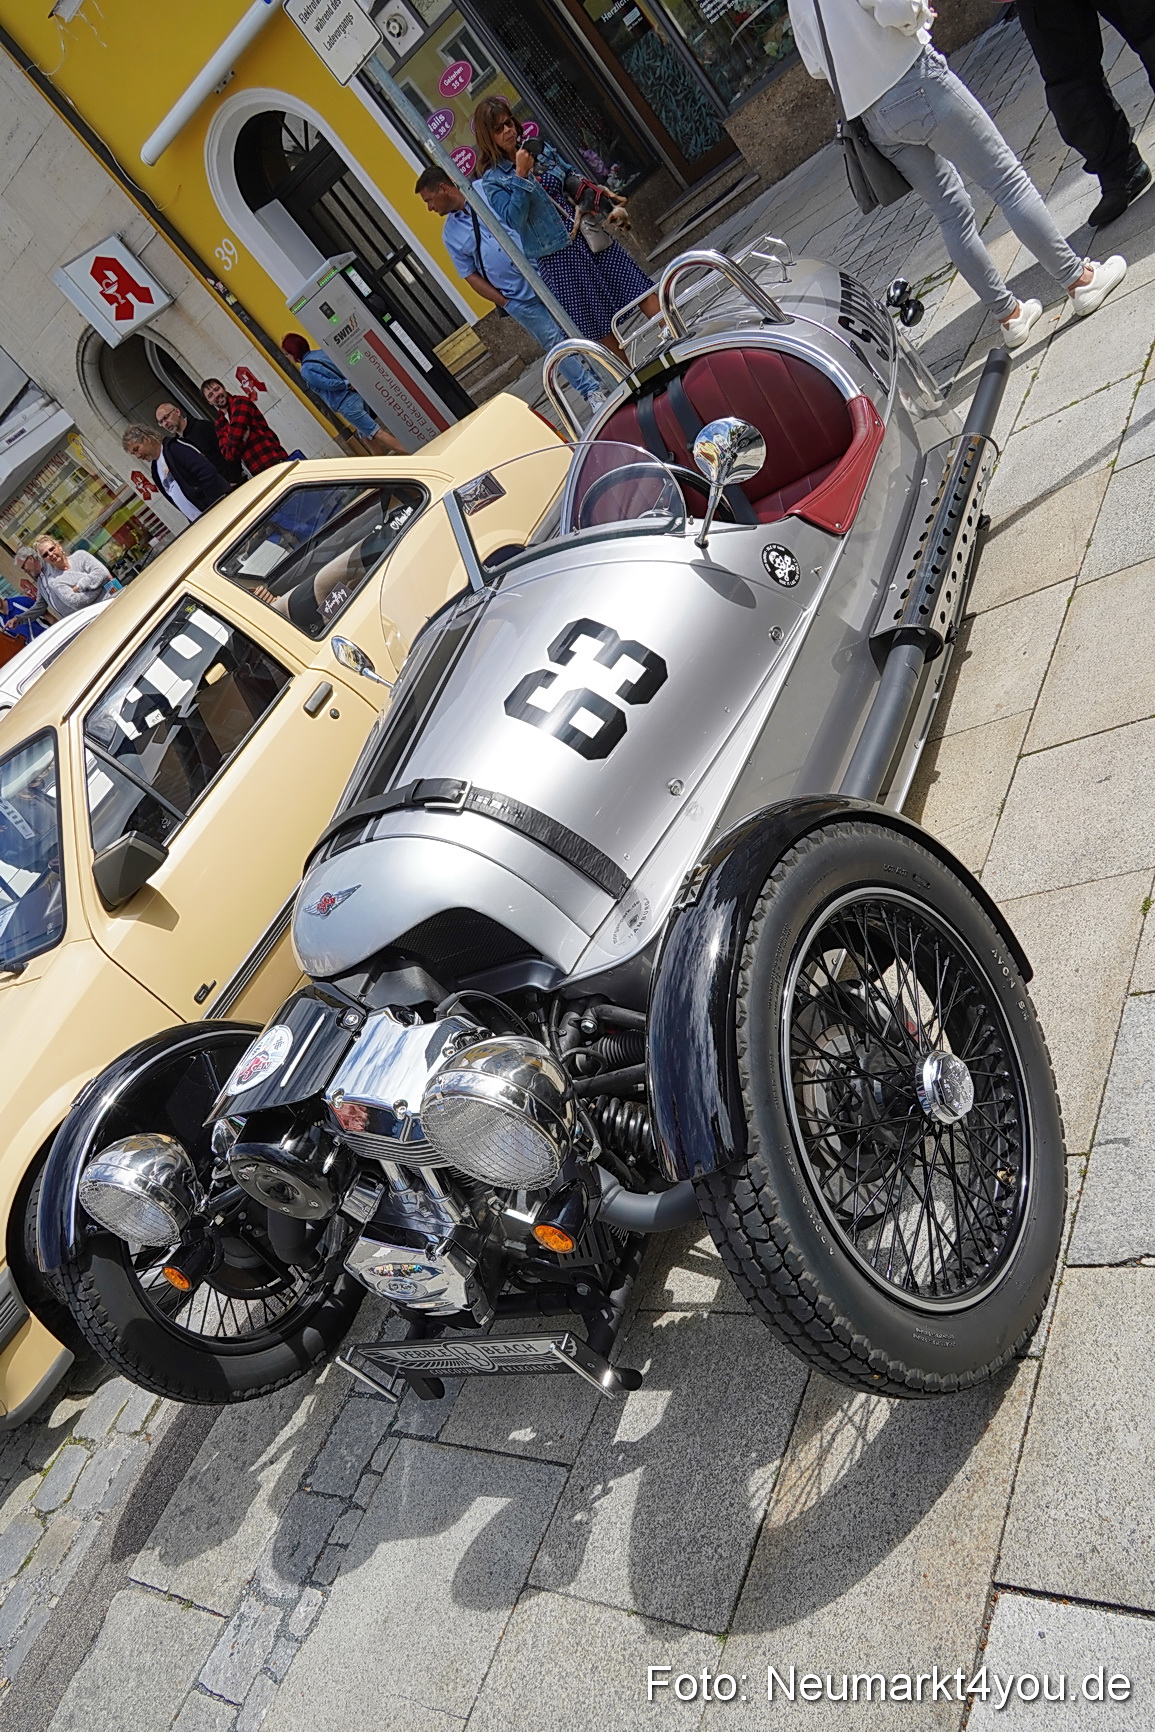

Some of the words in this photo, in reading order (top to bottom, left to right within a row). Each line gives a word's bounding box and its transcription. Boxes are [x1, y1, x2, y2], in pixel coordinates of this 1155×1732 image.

[298, 0, 321, 24] Elektrofa
[314, 4, 334, 33] während
[322, 12, 354, 51] Ladevorgangs
[444, 66, 464, 86] Gelzehen
[452, 80, 460, 89] 35
[444, 121, 450, 129] €
[214, 238, 238, 270] 39
[333, 322, 353, 346] swn
[364, 350, 427, 428] Elektrofahrzeuge
[425, 427, 437, 438] ür
[22, 450, 69, 501] APOTHEKE
[503, 617, 669, 761] 63
[396, 1348, 453, 1360] PEBBLE
[483, 1343, 539, 1356] BEACH
[428, 1366, 480, 1376] CONCOURS
